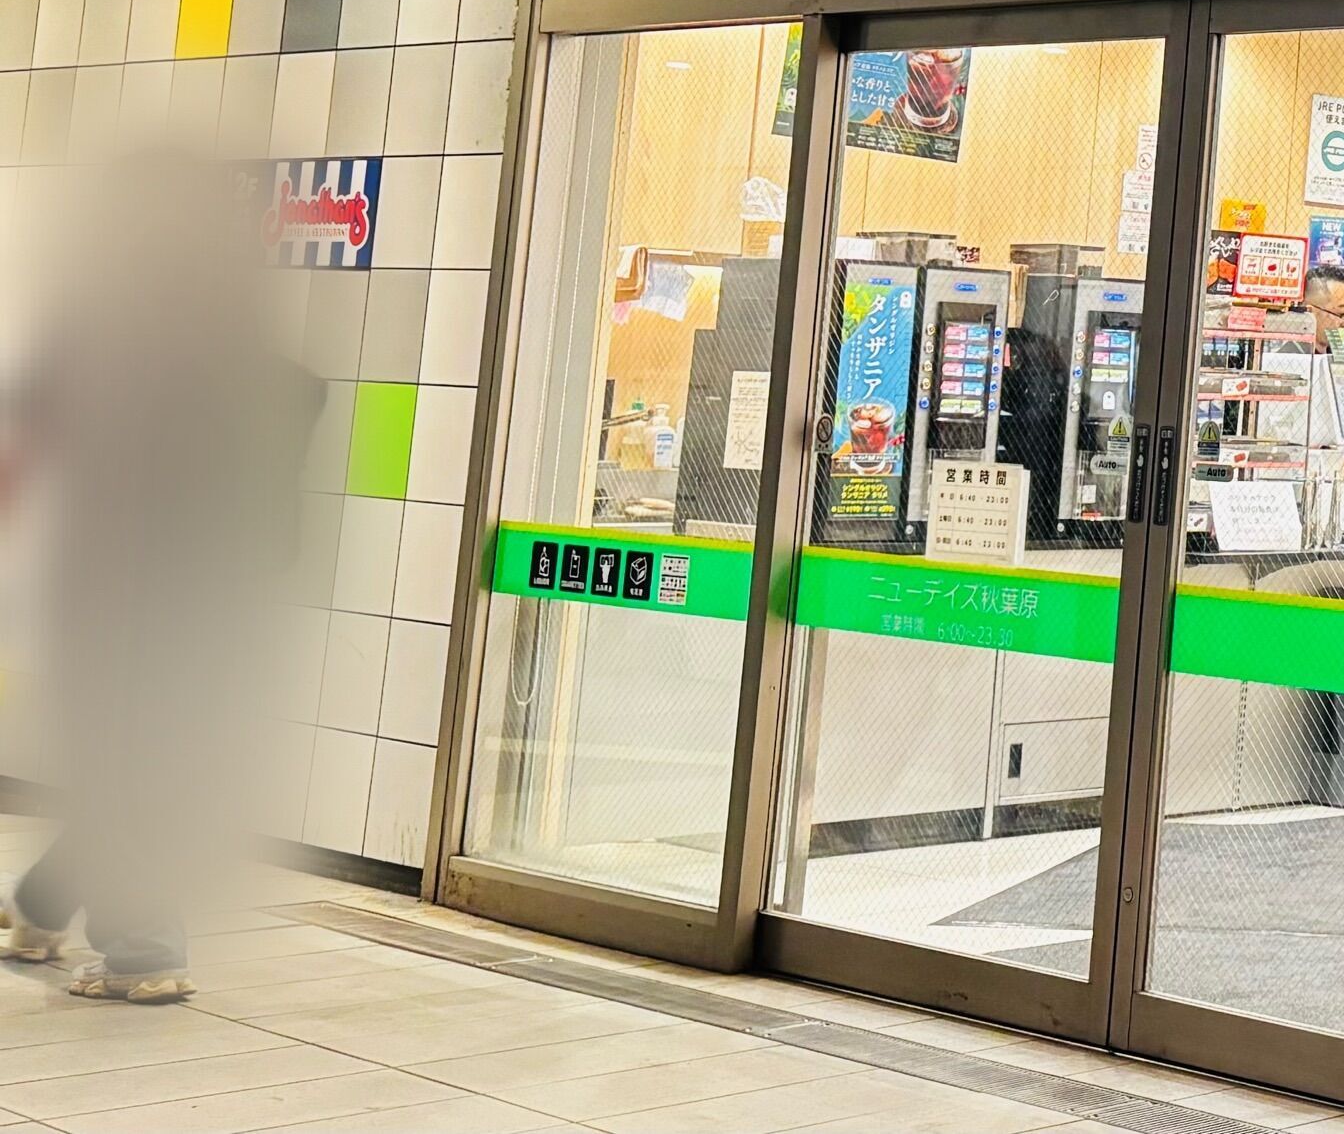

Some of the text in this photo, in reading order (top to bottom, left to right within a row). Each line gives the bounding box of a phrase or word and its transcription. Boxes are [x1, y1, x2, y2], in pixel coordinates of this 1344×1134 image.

[1318, 101, 1334, 113] JRE
[863, 294, 887, 400] タンザニア
[946, 468, 1007, 485] 営業時間
[1206, 467, 1226, 477] Auto
[867, 575, 1041, 619] ニューデイズ秋葉原
